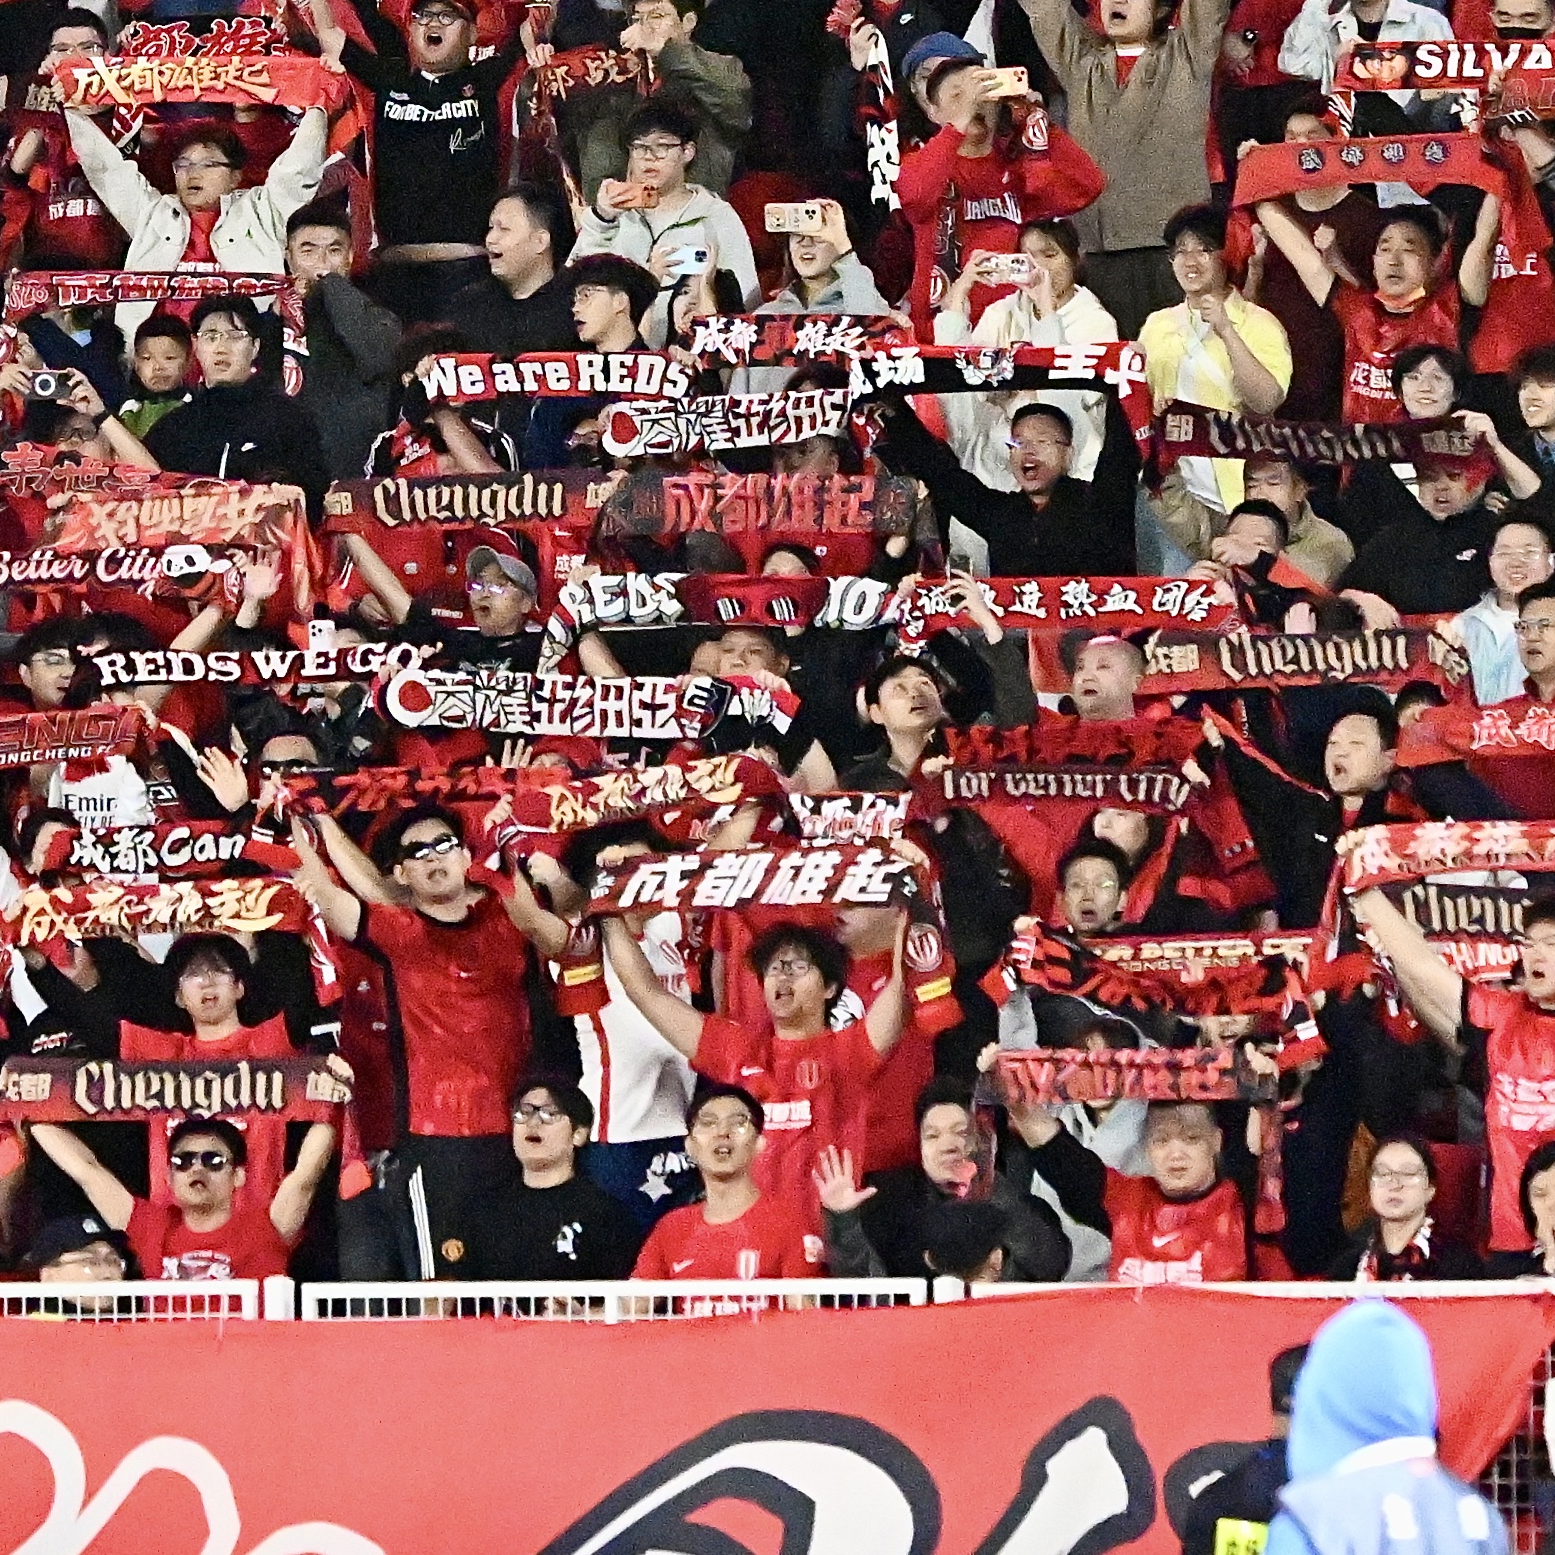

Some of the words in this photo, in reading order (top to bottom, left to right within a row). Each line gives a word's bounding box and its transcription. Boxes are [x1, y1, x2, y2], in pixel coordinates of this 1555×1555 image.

[71, 55, 276, 109] 成都雄起
[1415, 42, 1554, 80] SILVA
[691, 317, 758, 363] 成都
[793, 317, 867, 358] 雄起
[423, 356, 487, 401] We
[494, 364, 571, 395] are
[576, 352, 690, 399] REDS
[373, 472, 564, 528] Chengdu
[662, 473, 876, 533] 成都雄起
[96, 544, 164, 601] City
[96, 648, 242, 685] REDS
[250, 646, 337, 681] WE
[348, 642, 423, 674] GO
[1220, 632, 1409, 680] Chengdu
[70, 825, 155, 873] 成都
[619, 851, 912, 907] 成都雄起
[74, 1061, 287, 1117] Chengdu
